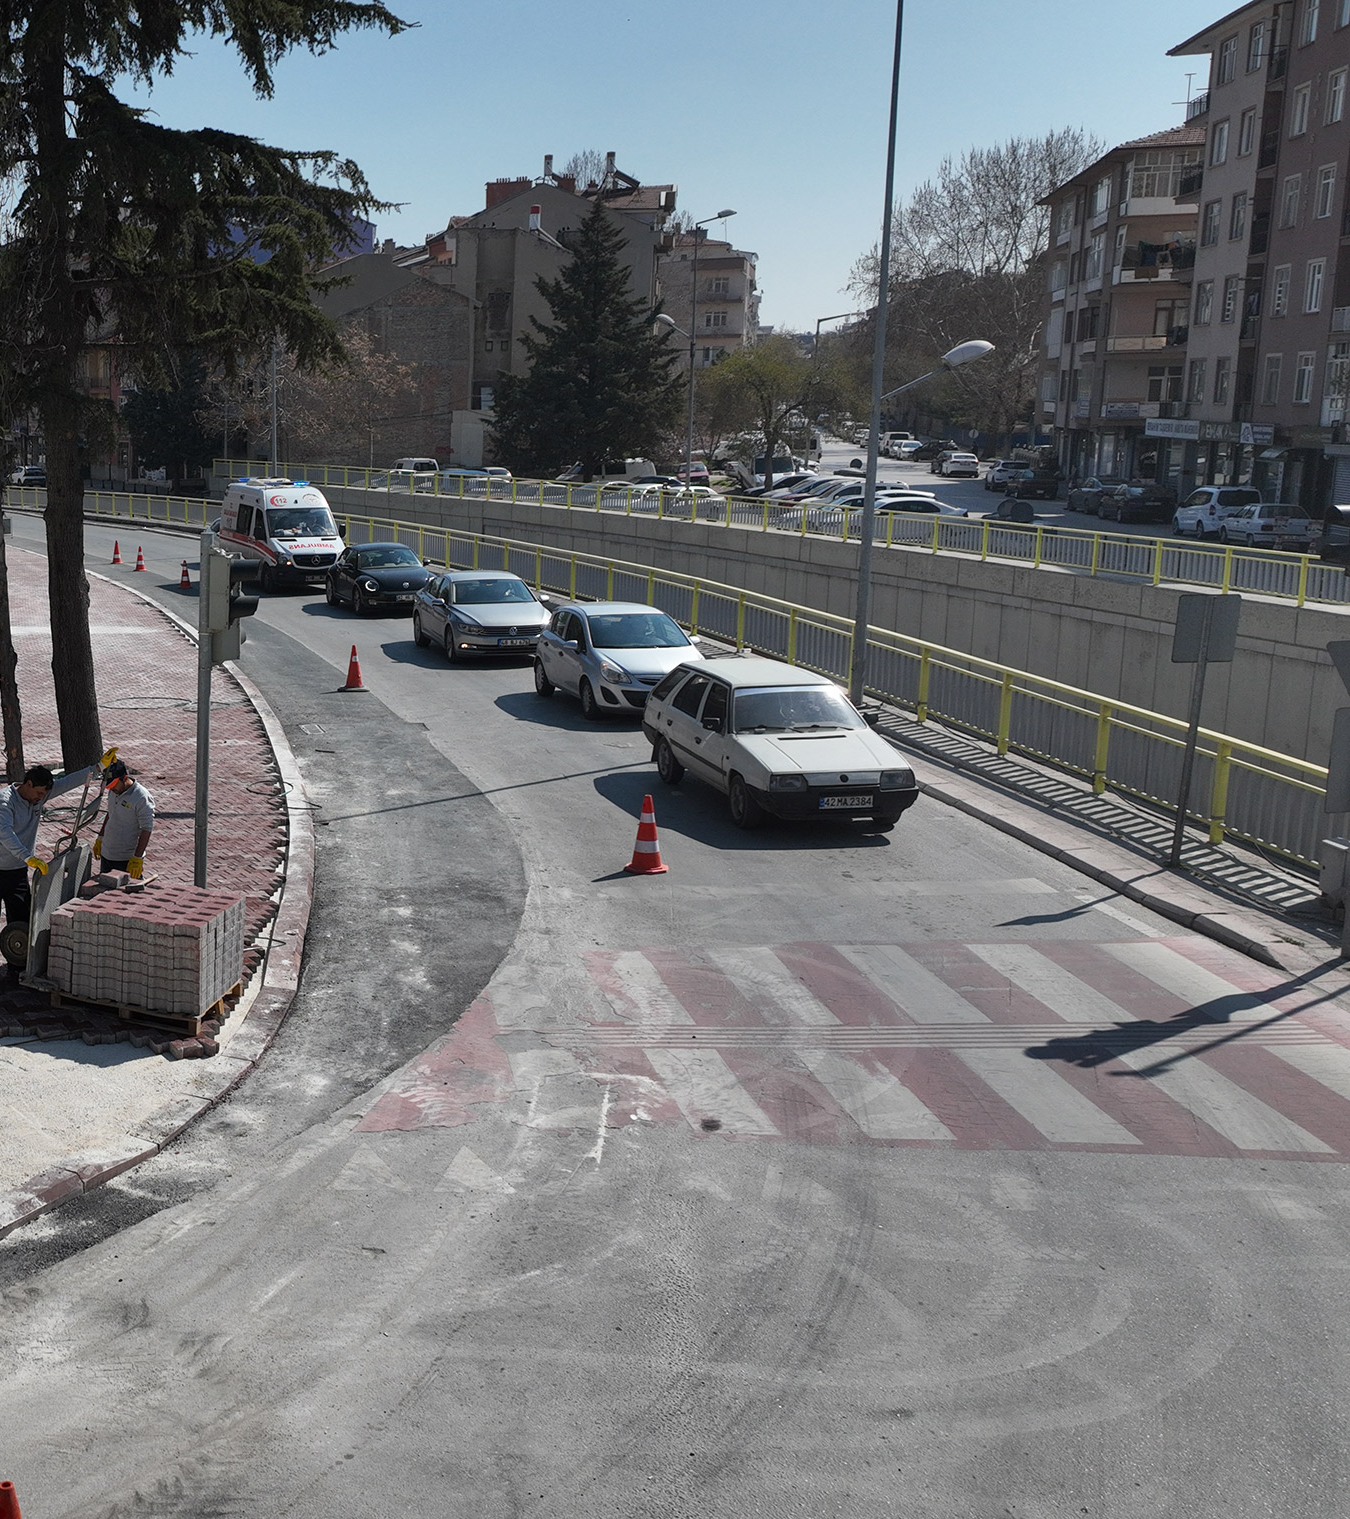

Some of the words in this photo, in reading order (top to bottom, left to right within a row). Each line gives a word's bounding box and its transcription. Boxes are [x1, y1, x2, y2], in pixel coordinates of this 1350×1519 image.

[275, 497, 288, 505] 112
[825, 798, 836, 807] 42
[850, 797, 871, 806] 2384
